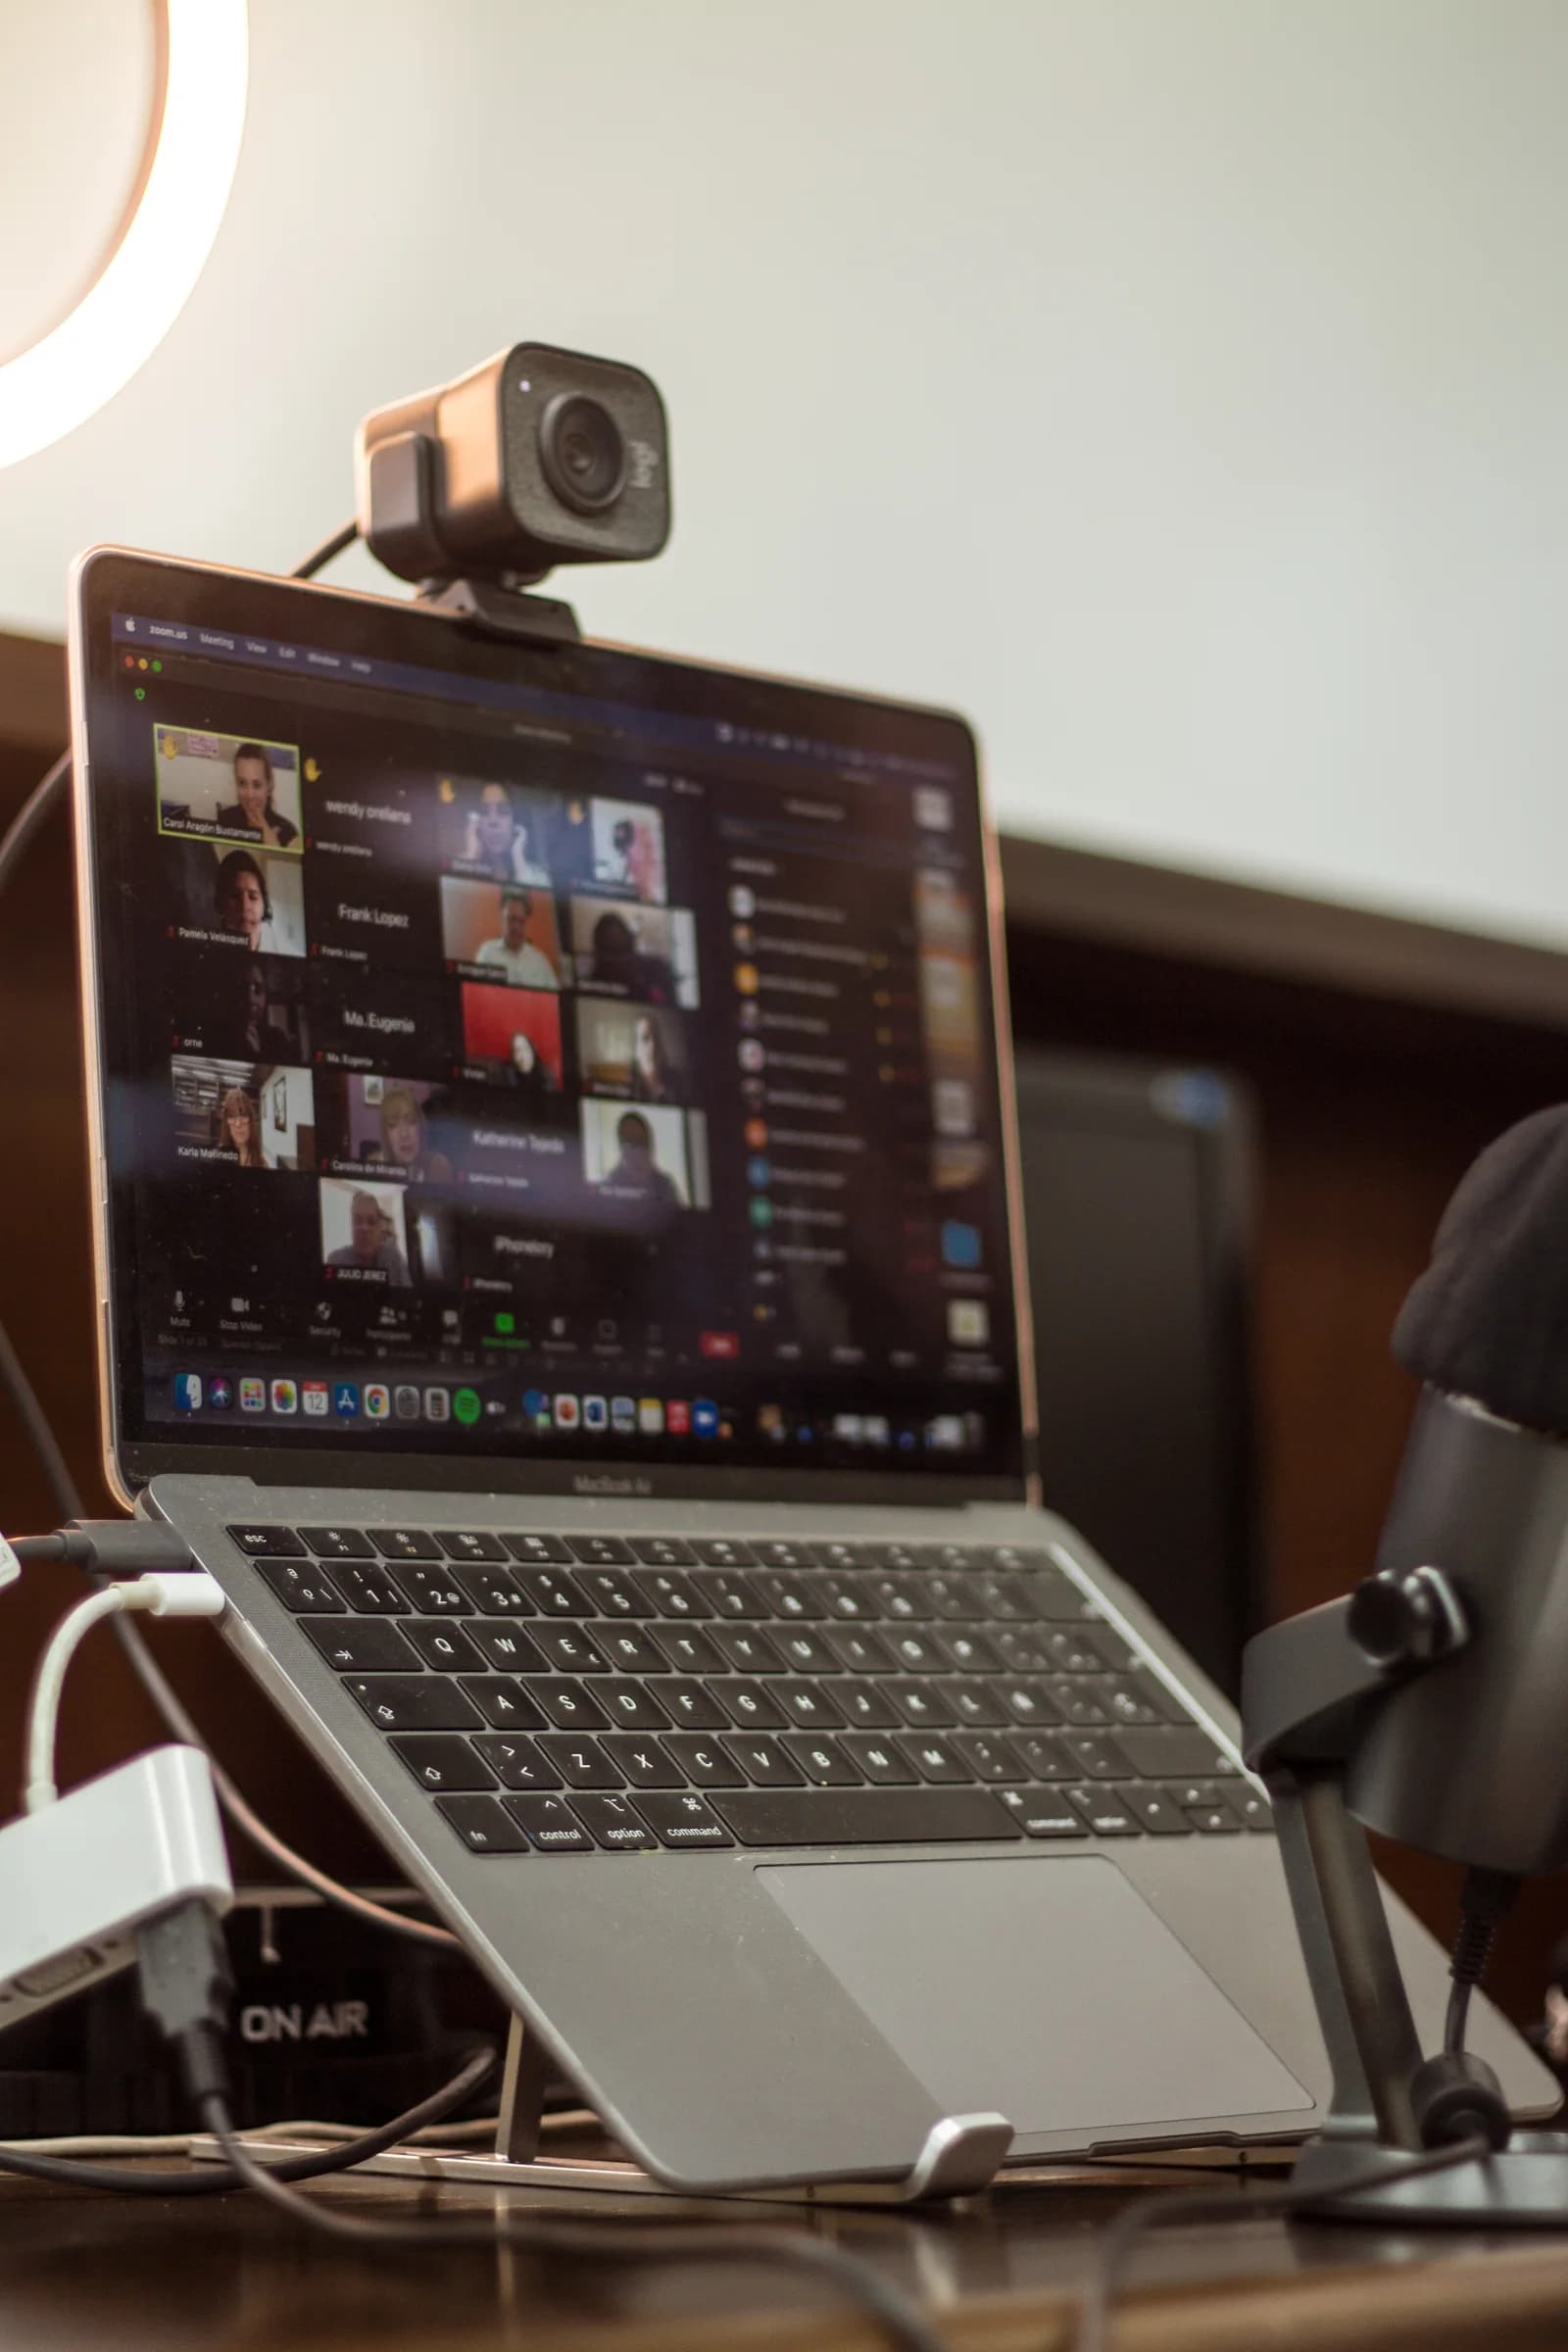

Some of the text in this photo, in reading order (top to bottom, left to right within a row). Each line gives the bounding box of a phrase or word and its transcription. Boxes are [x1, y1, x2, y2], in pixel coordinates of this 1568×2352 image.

[149, 624, 188, 640] zoom.us
[200, 632, 234, 650] Meeting
[247, 641, 268, 654] View
[279, 647, 296, 659] Edit
[308, 653, 340, 667] Window
[326, 801, 365, 820] wendy
[164, 817, 184, 828] Carol
[338, 903, 410, 929] Frank Lopez
[179, 927, 208, 940] Pamela
[344, 1010, 416, 1033] Ma. Eugenia
[178, 1146, 199, 1157] Karla
[170, 1316, 191, 1328] Mute
[308, 1393, 324, 1411] 12
[245, 1534, 267, 1544] esc
[367, 1590, 380, 1603] 1
[429, 1591, 447, 1605] 2
[492, 1592, 509, 1606] 3
[555, 1592, 569, 1607] 4
[612, 1593, 630, 1610] 5
[669, 1594, 689, 1611] 6
[434, 1638, 455, 1653] Q
[493, 1638, 517, 1653] W
[559, 1639, 577, 1653] E
[618, 1639, 638, 1654] R
[677, 1640, 695, 1655] T
[735, 1640, 753, 1655] Y
[791, 1641, 812, 1656] U
[497, 1694, 514, 1709] A
[559, 1694, 576, 1710] S
[618, 1695, 637, 1710] D
[679, 1695, 694, 1710] F
[738, 1695, 757, 1711] G
[794, 1694, 815, 1711] H
[571, 1753, 590, 1768] Z
[633, 1753, 654, 1769] X
[695, 1752, 713, 1768] C
[752, 1752, 770, 1768] V
[811, 1751, 831, 1767] B
[470, 1829, 487, 1841] fn
[539, 1828, 582, 1840] control
[608, 1828, 645, 1842] option
[667, 1826, 722, 1838] command
[241, 2000, 368, 2042] ON AIR
